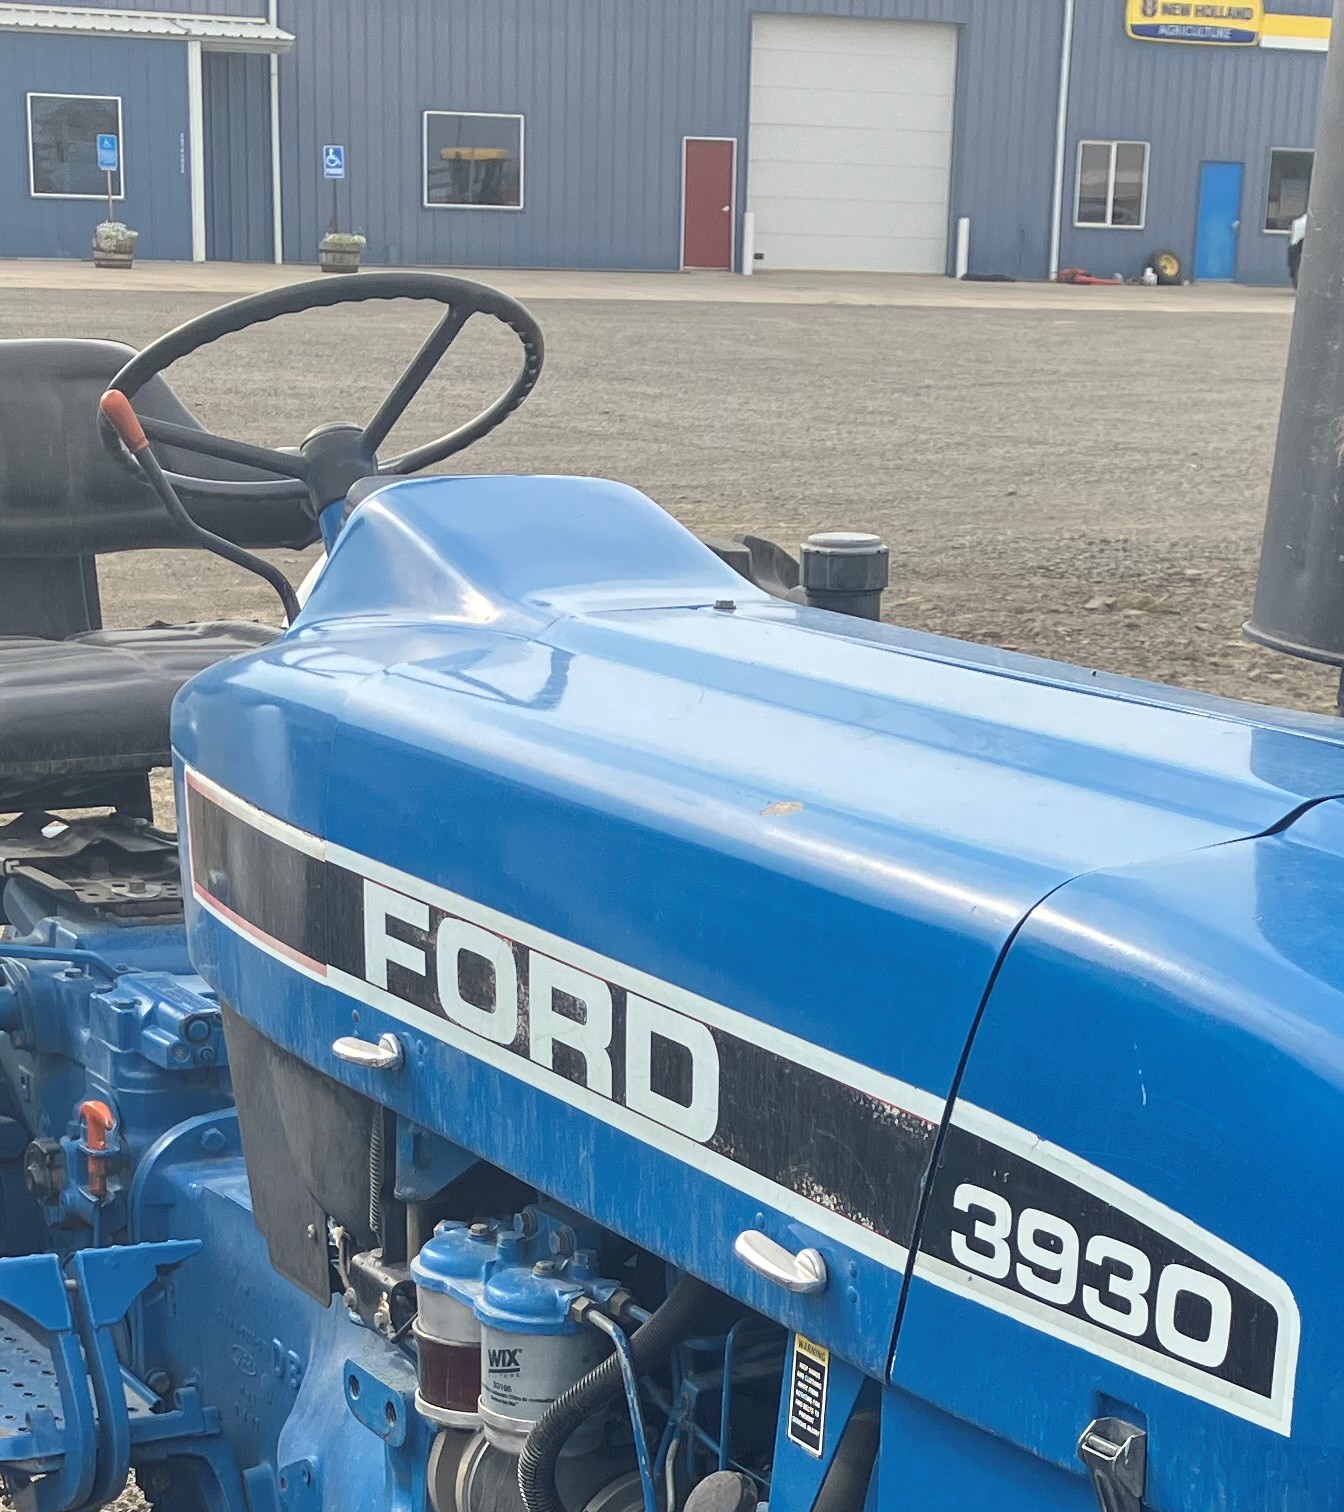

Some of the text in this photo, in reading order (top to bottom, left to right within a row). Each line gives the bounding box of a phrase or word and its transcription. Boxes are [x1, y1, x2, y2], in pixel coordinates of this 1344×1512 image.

[1162, 4, 1254, 19] NEW HOLLAND
[363, 880, 720, 1143] FORD
[950, 1183, 1233, 1368] 3930
[488, 1348, 521, 1367] WIX
